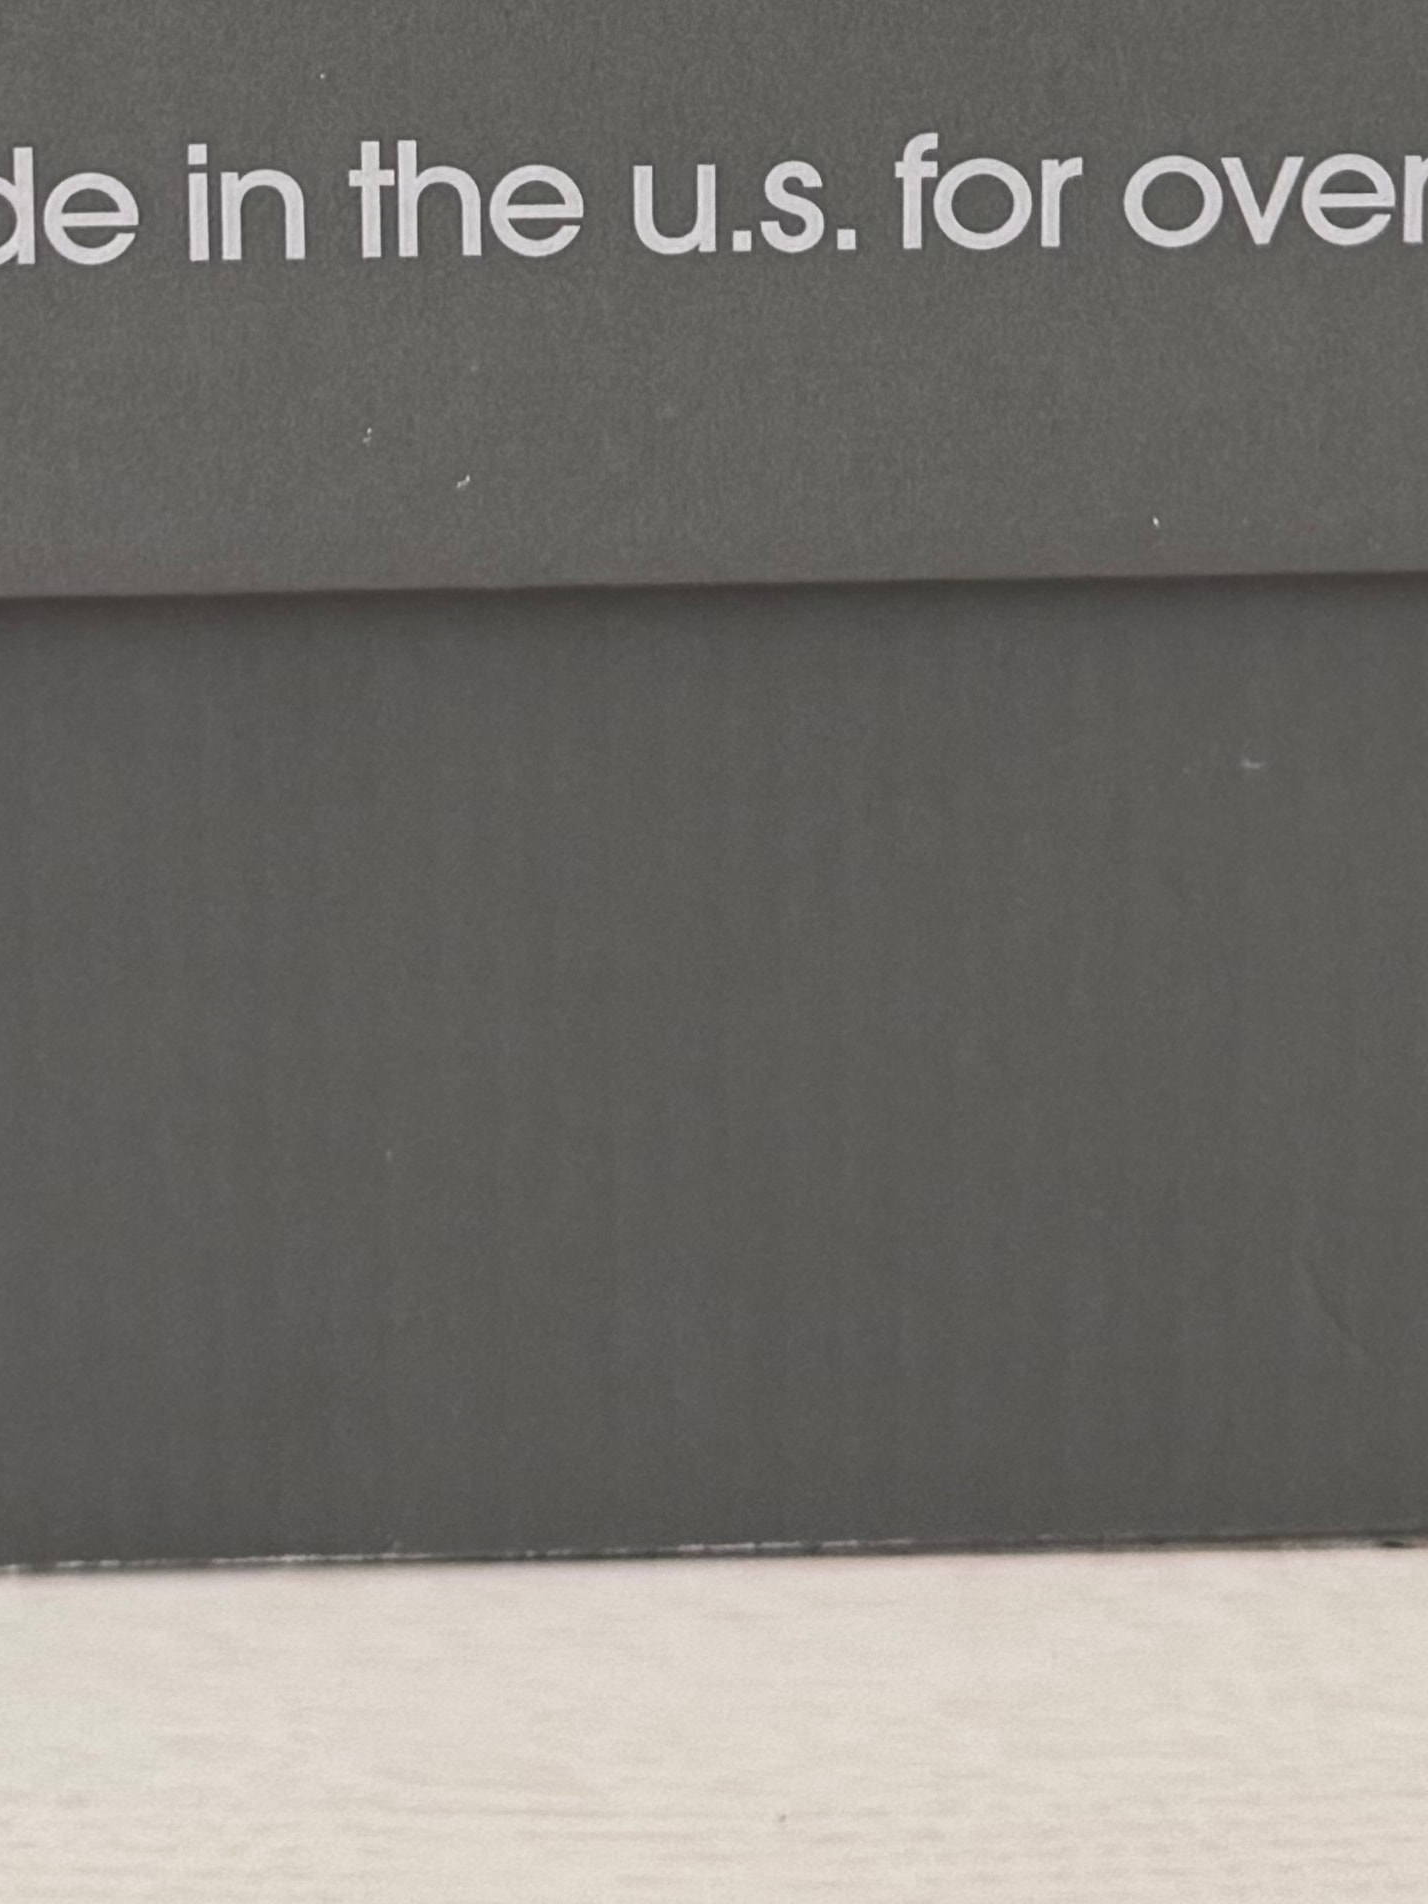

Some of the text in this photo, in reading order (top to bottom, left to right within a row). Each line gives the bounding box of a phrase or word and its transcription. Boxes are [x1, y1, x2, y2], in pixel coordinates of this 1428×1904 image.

[186, 142, 307, 263] in
[347, 138, 585, 259] the
[632, 159, 858, 256] u.s.
[893, 131, 1083, 252] for
